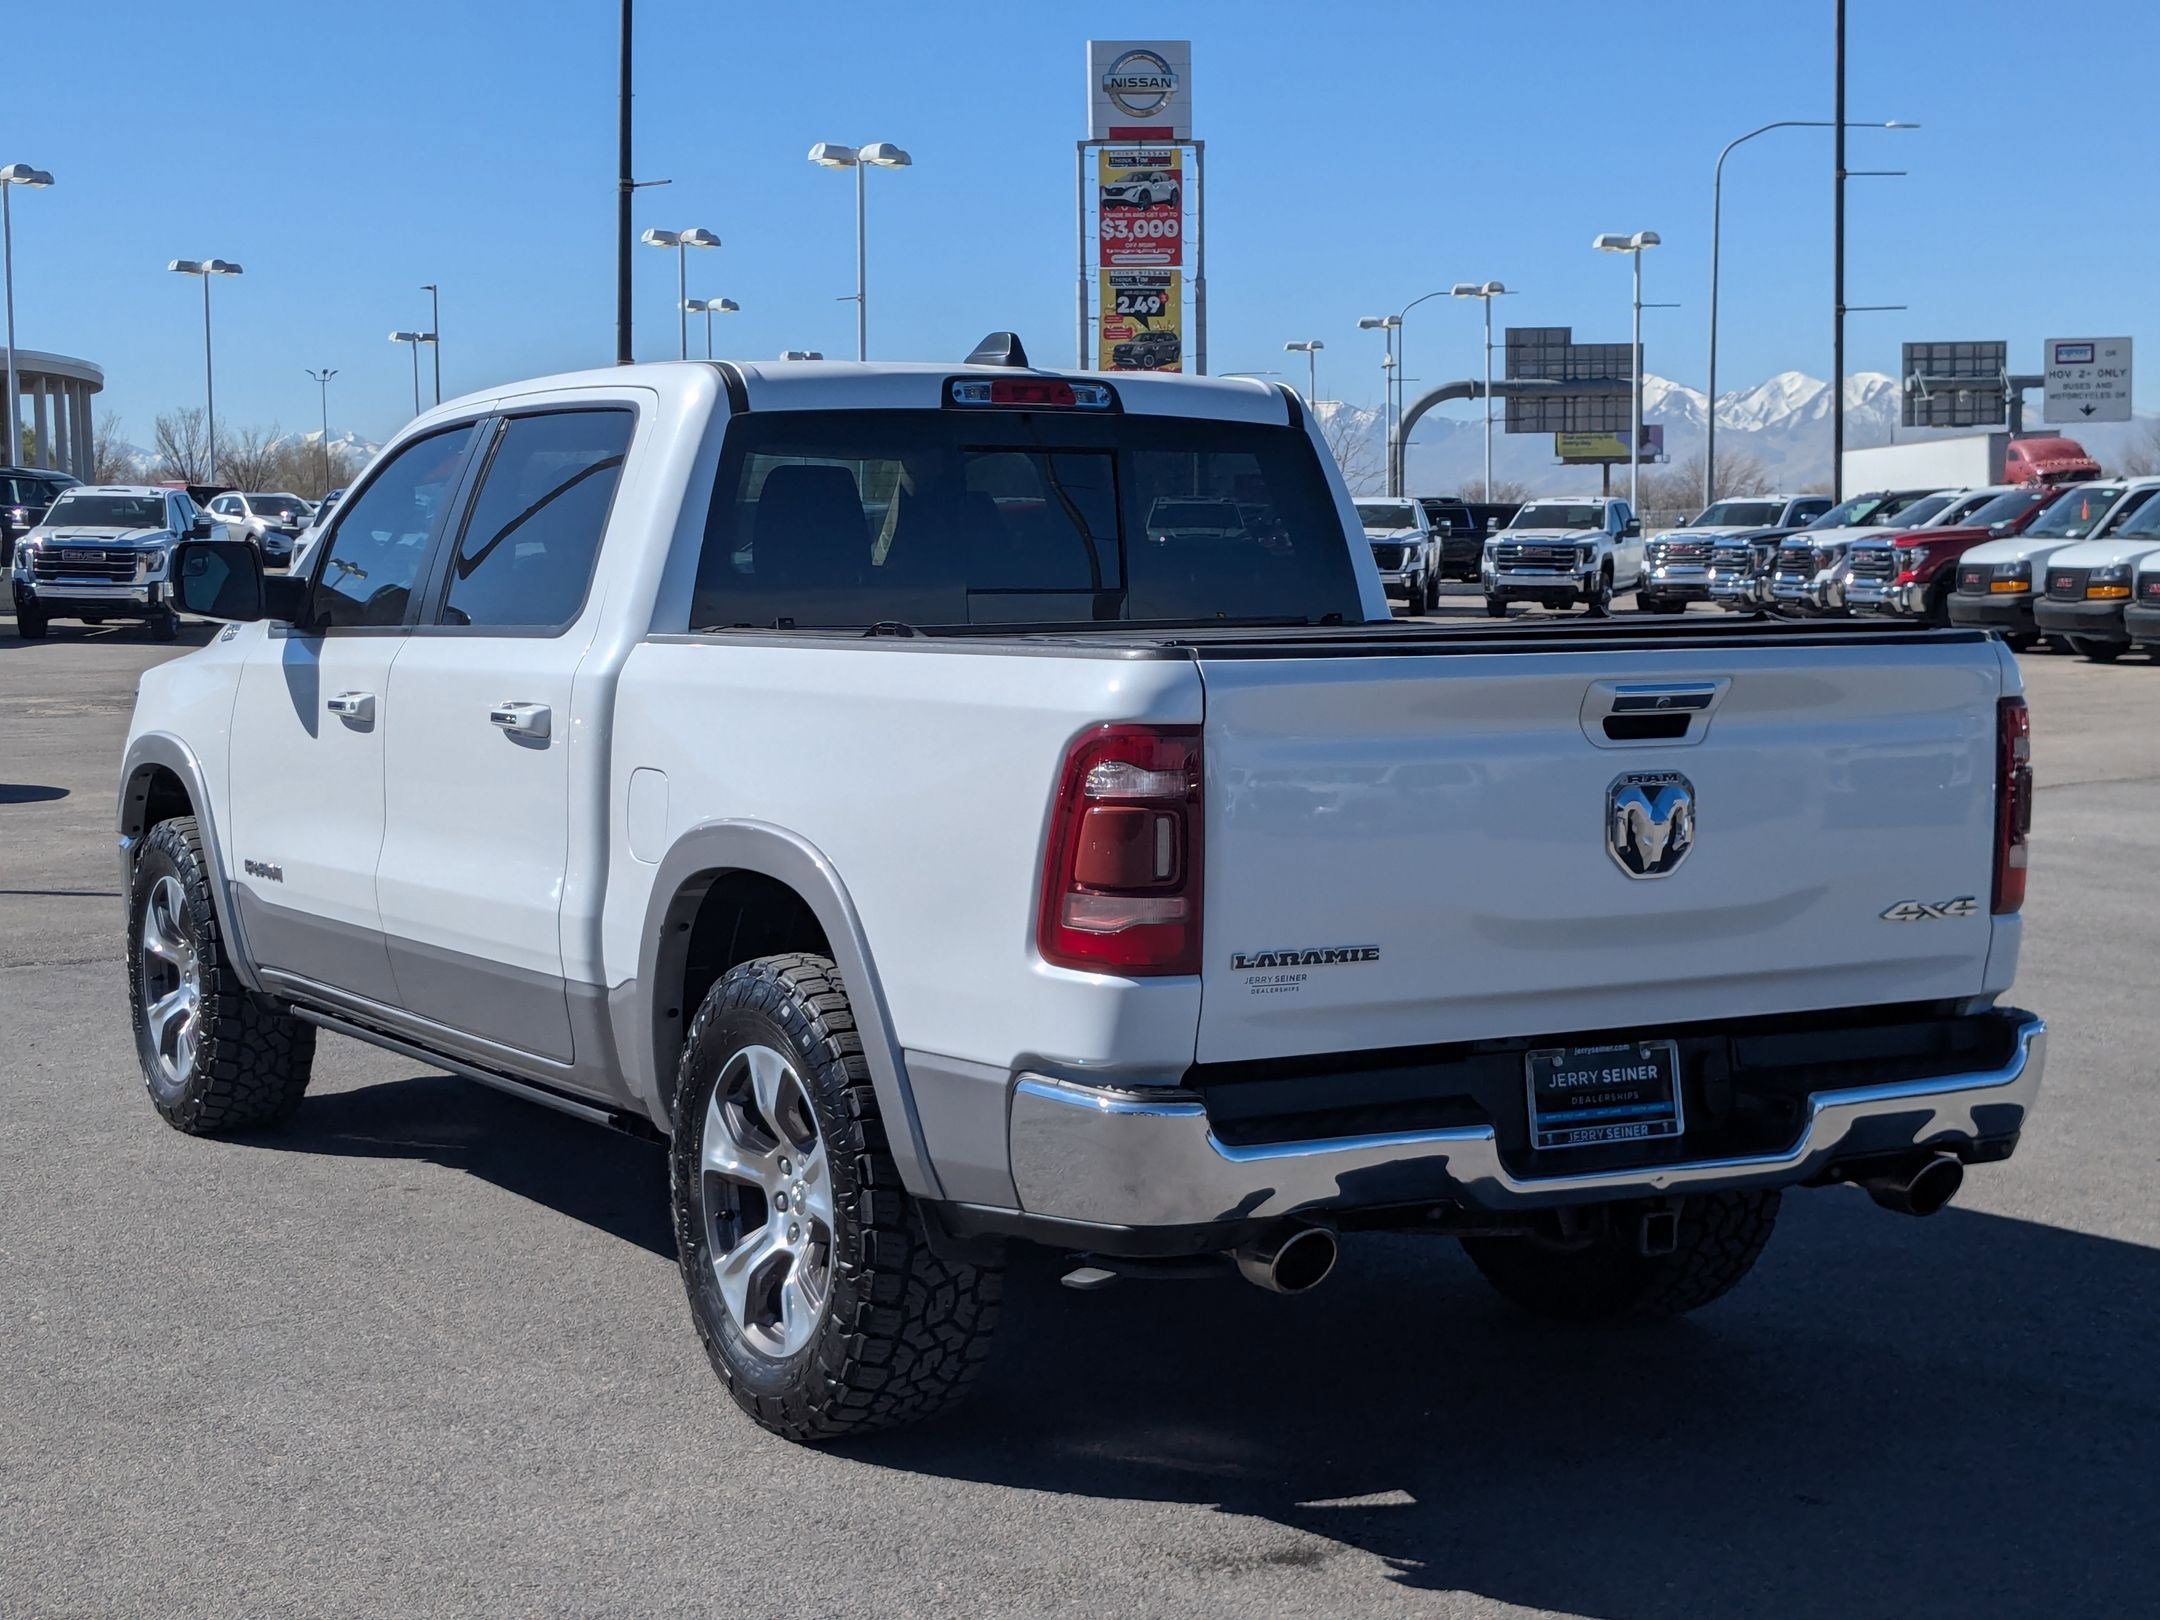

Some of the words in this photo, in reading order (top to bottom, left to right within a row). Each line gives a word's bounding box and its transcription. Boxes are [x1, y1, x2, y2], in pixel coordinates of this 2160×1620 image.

[1111, 77, 1172, 88] NISSAN
[1117, 296, 1160, 313] 2.49
[2049, 370, 2072, 379] HOV
[2097, 368, 2127, 378] ONLY
[2062, 382, 2091, 390] BUSES
[2095, 381, 2113, 389] AND
[1627, 773, 1679, 784] RAM
[1233, 946, 1380, 970] LARAMIE
[1245, 975, 1273, 985] JERRY
[1274, 973, 1308, 983] SEINER
[1251, 986, 1300, 995] DEALERSHIPS
[1549, 1070, 1599, 1088] JERRY
[1602, 1065, 1658, 1083] SEINER
[1571, 1090, 1640, 1105] DEALERSHIPS
[1567, 1129, 1603, 1143] JERRY
[1606, 1125, 1649, 1139] SEINER
